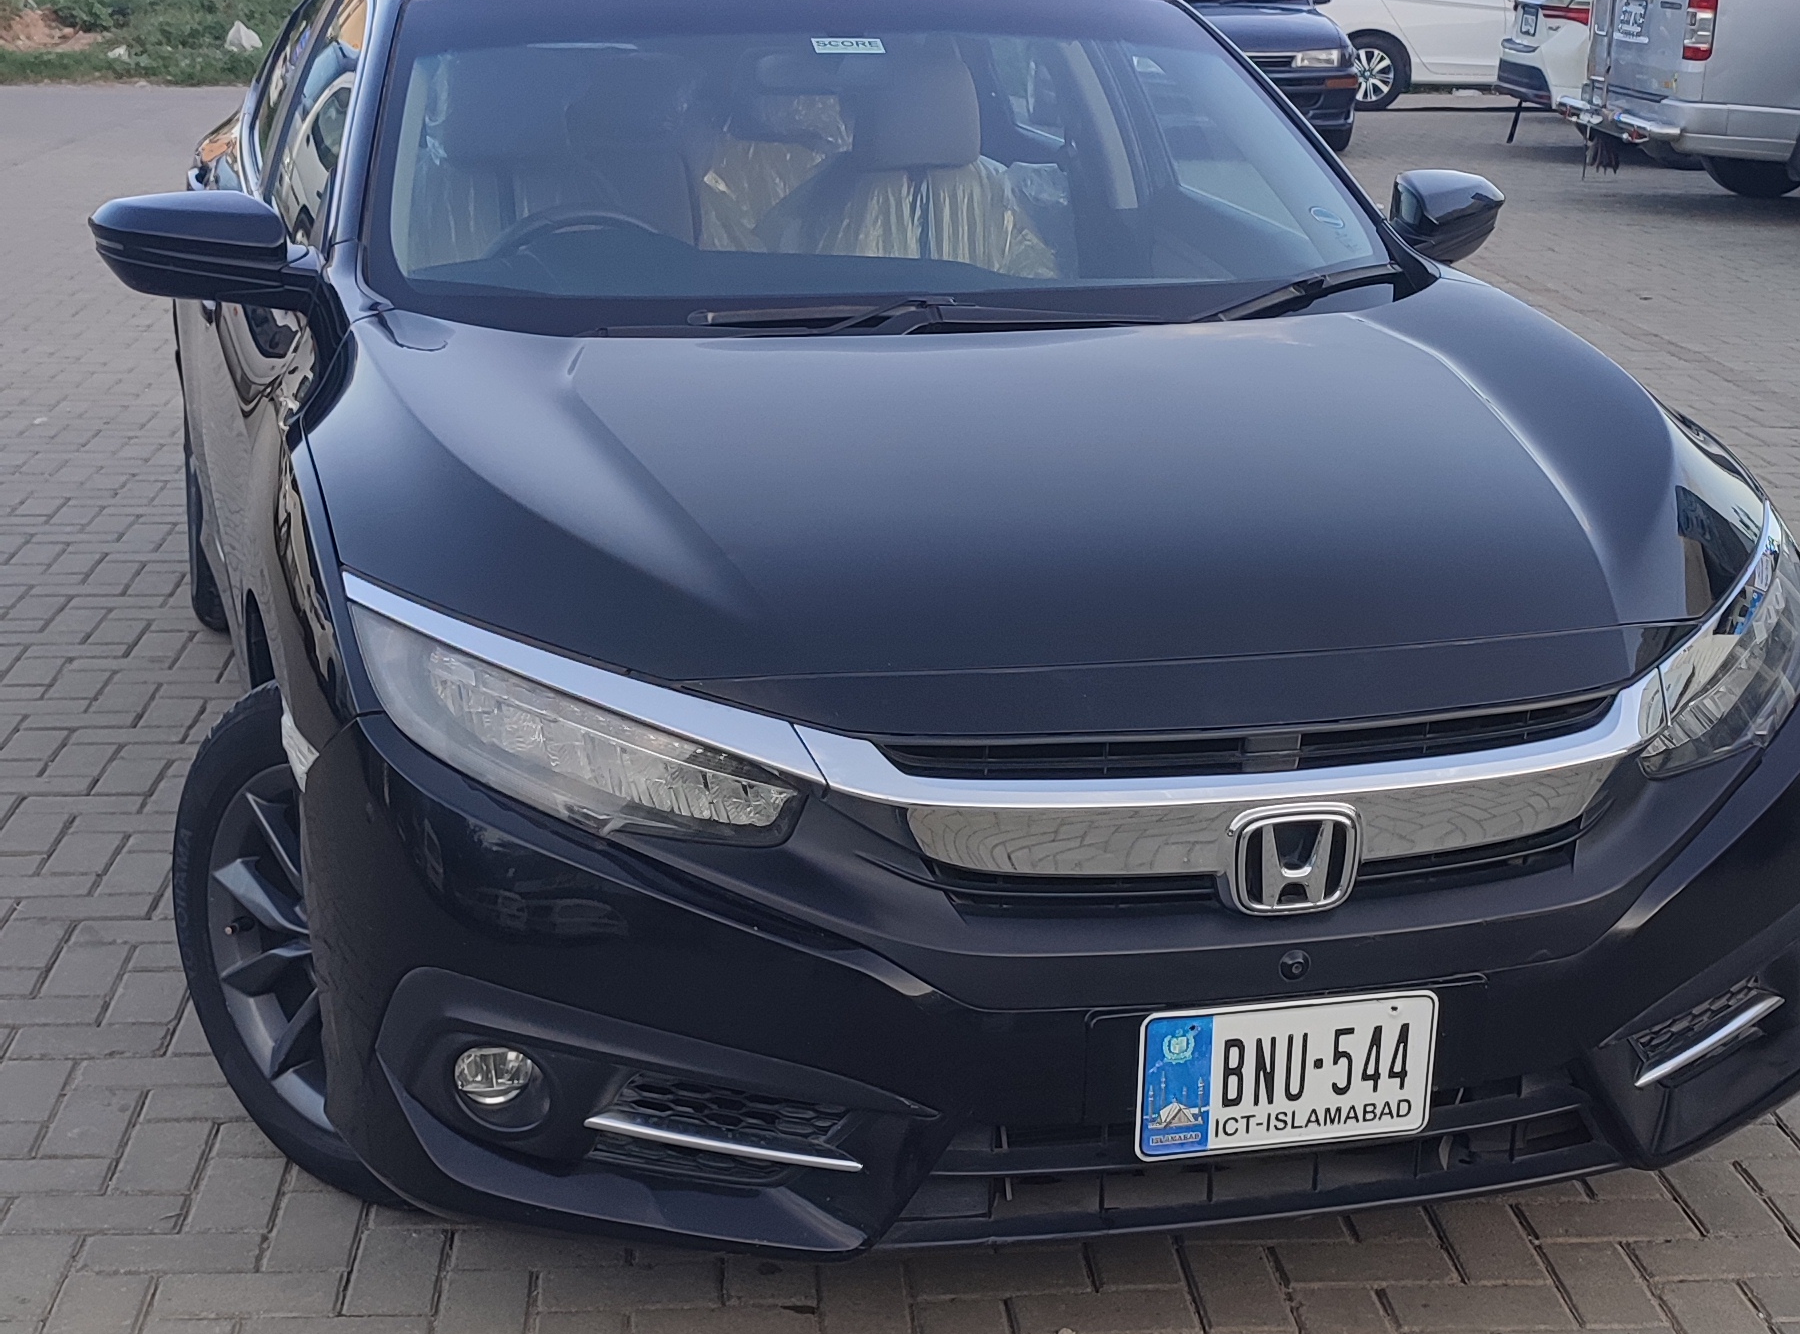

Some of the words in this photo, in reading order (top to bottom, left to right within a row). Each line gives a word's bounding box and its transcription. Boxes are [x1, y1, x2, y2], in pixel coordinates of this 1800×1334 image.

[815, 39, 880, 48] SCORE
[1214, 1098, 1413, 1138] ICT-ISLAMABAD
[1150, 1131, 1201, 1145] ISLAMABAD
